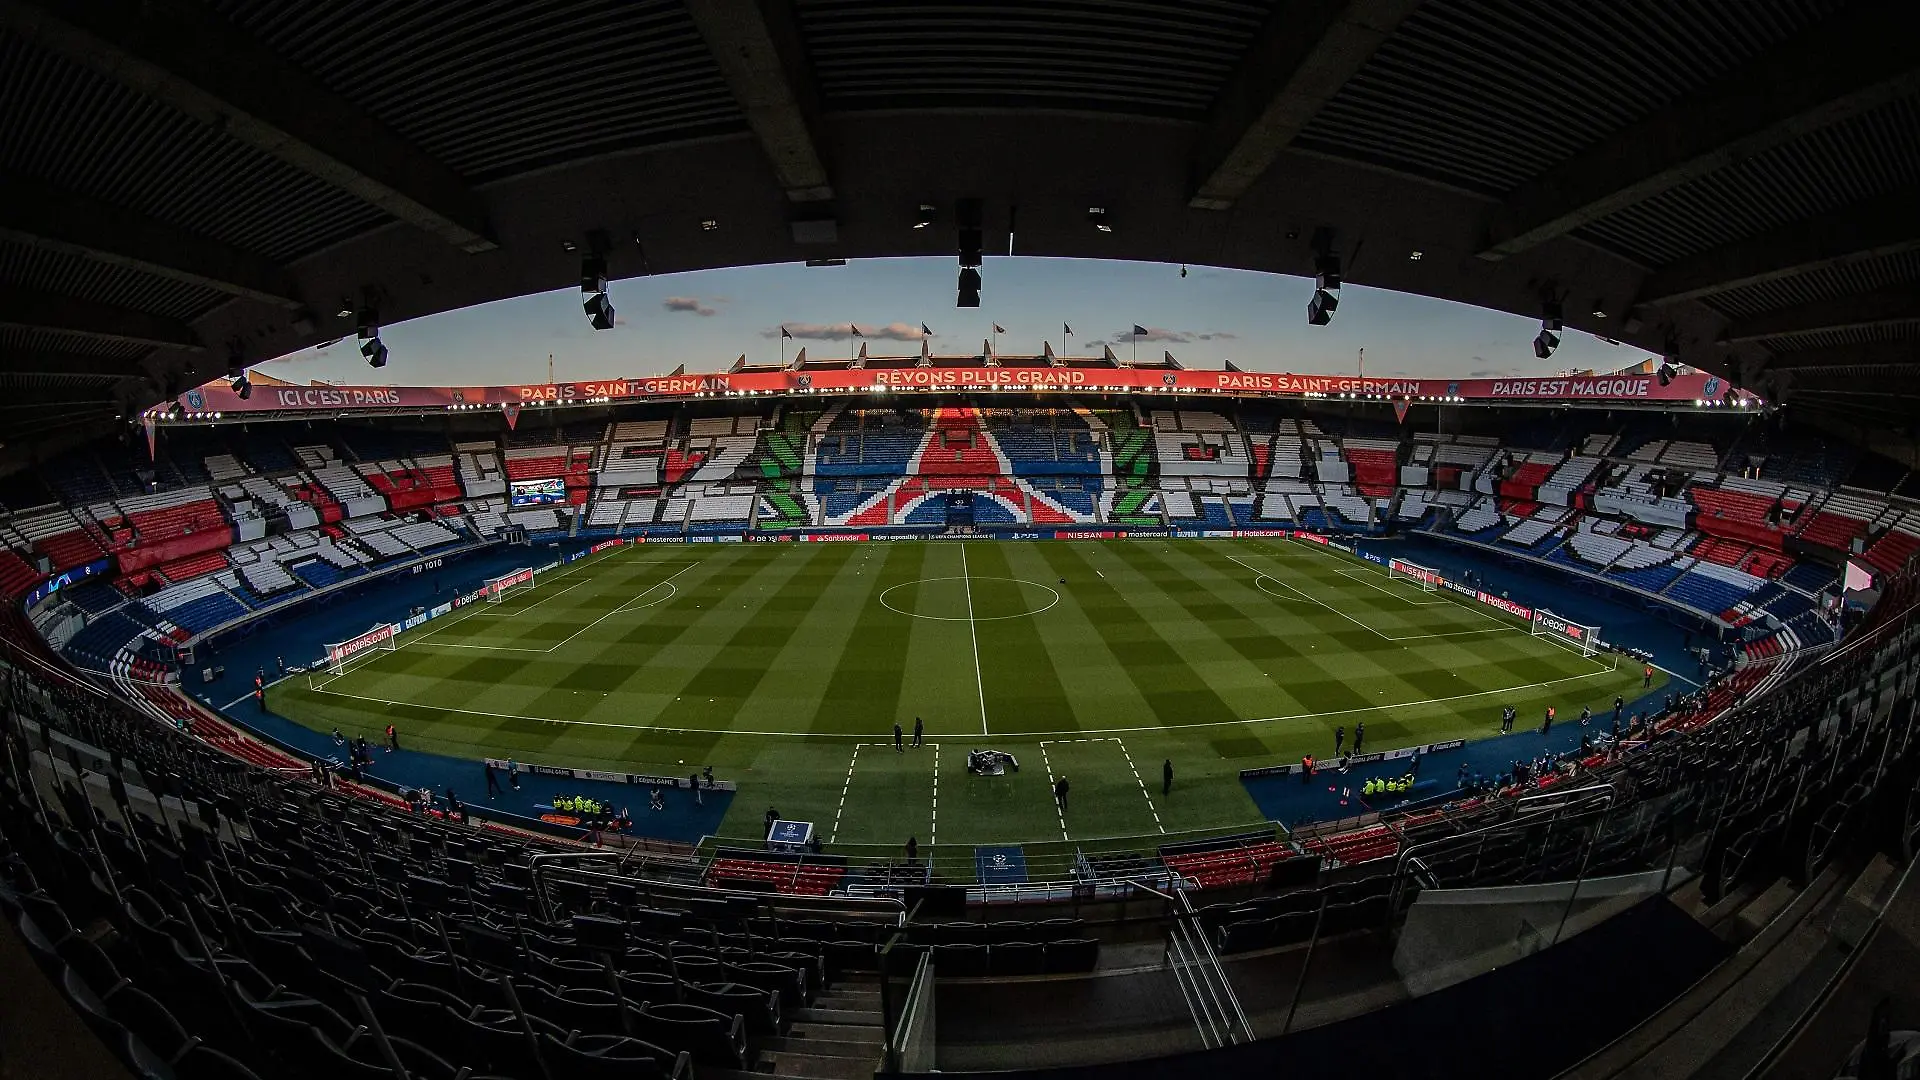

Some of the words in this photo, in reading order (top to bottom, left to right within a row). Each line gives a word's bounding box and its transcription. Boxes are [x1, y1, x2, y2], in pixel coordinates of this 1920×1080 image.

[876, 369, 957, 384] RÊVONS
[961, 371, 1012, 383] PLUS
[1016, 371, 1086, 383] GRAND
[1217, 375, 1273, 388] PARIS
[1277, 377, 1420, 394] SAINT-GERMAIN
[520, 385, 576, 400] PARIS
[584, 376, 731, 396] SAINT-GERMAIN
[1492, 381, 1537, 395] PARIS
[1538, 381, 1569, 395] EST
[1571, 379, 1650, 397] MAGIQUE
[277, 390, 302, 406] ICI
[304, 390, 350, 405] C'EST
[353, 390, 400, 404] PARIS
[824, 534, 860, 542] Santander
[1401, 564, 1426, 581] NISSAN
[1443, 580, 1477, 597] mastercard
[1487, 594, 1527, 619] Hotels.com
[1542, 616, 1566, 633] pepsi
[345, 629, 389, 655] Hotels.com
